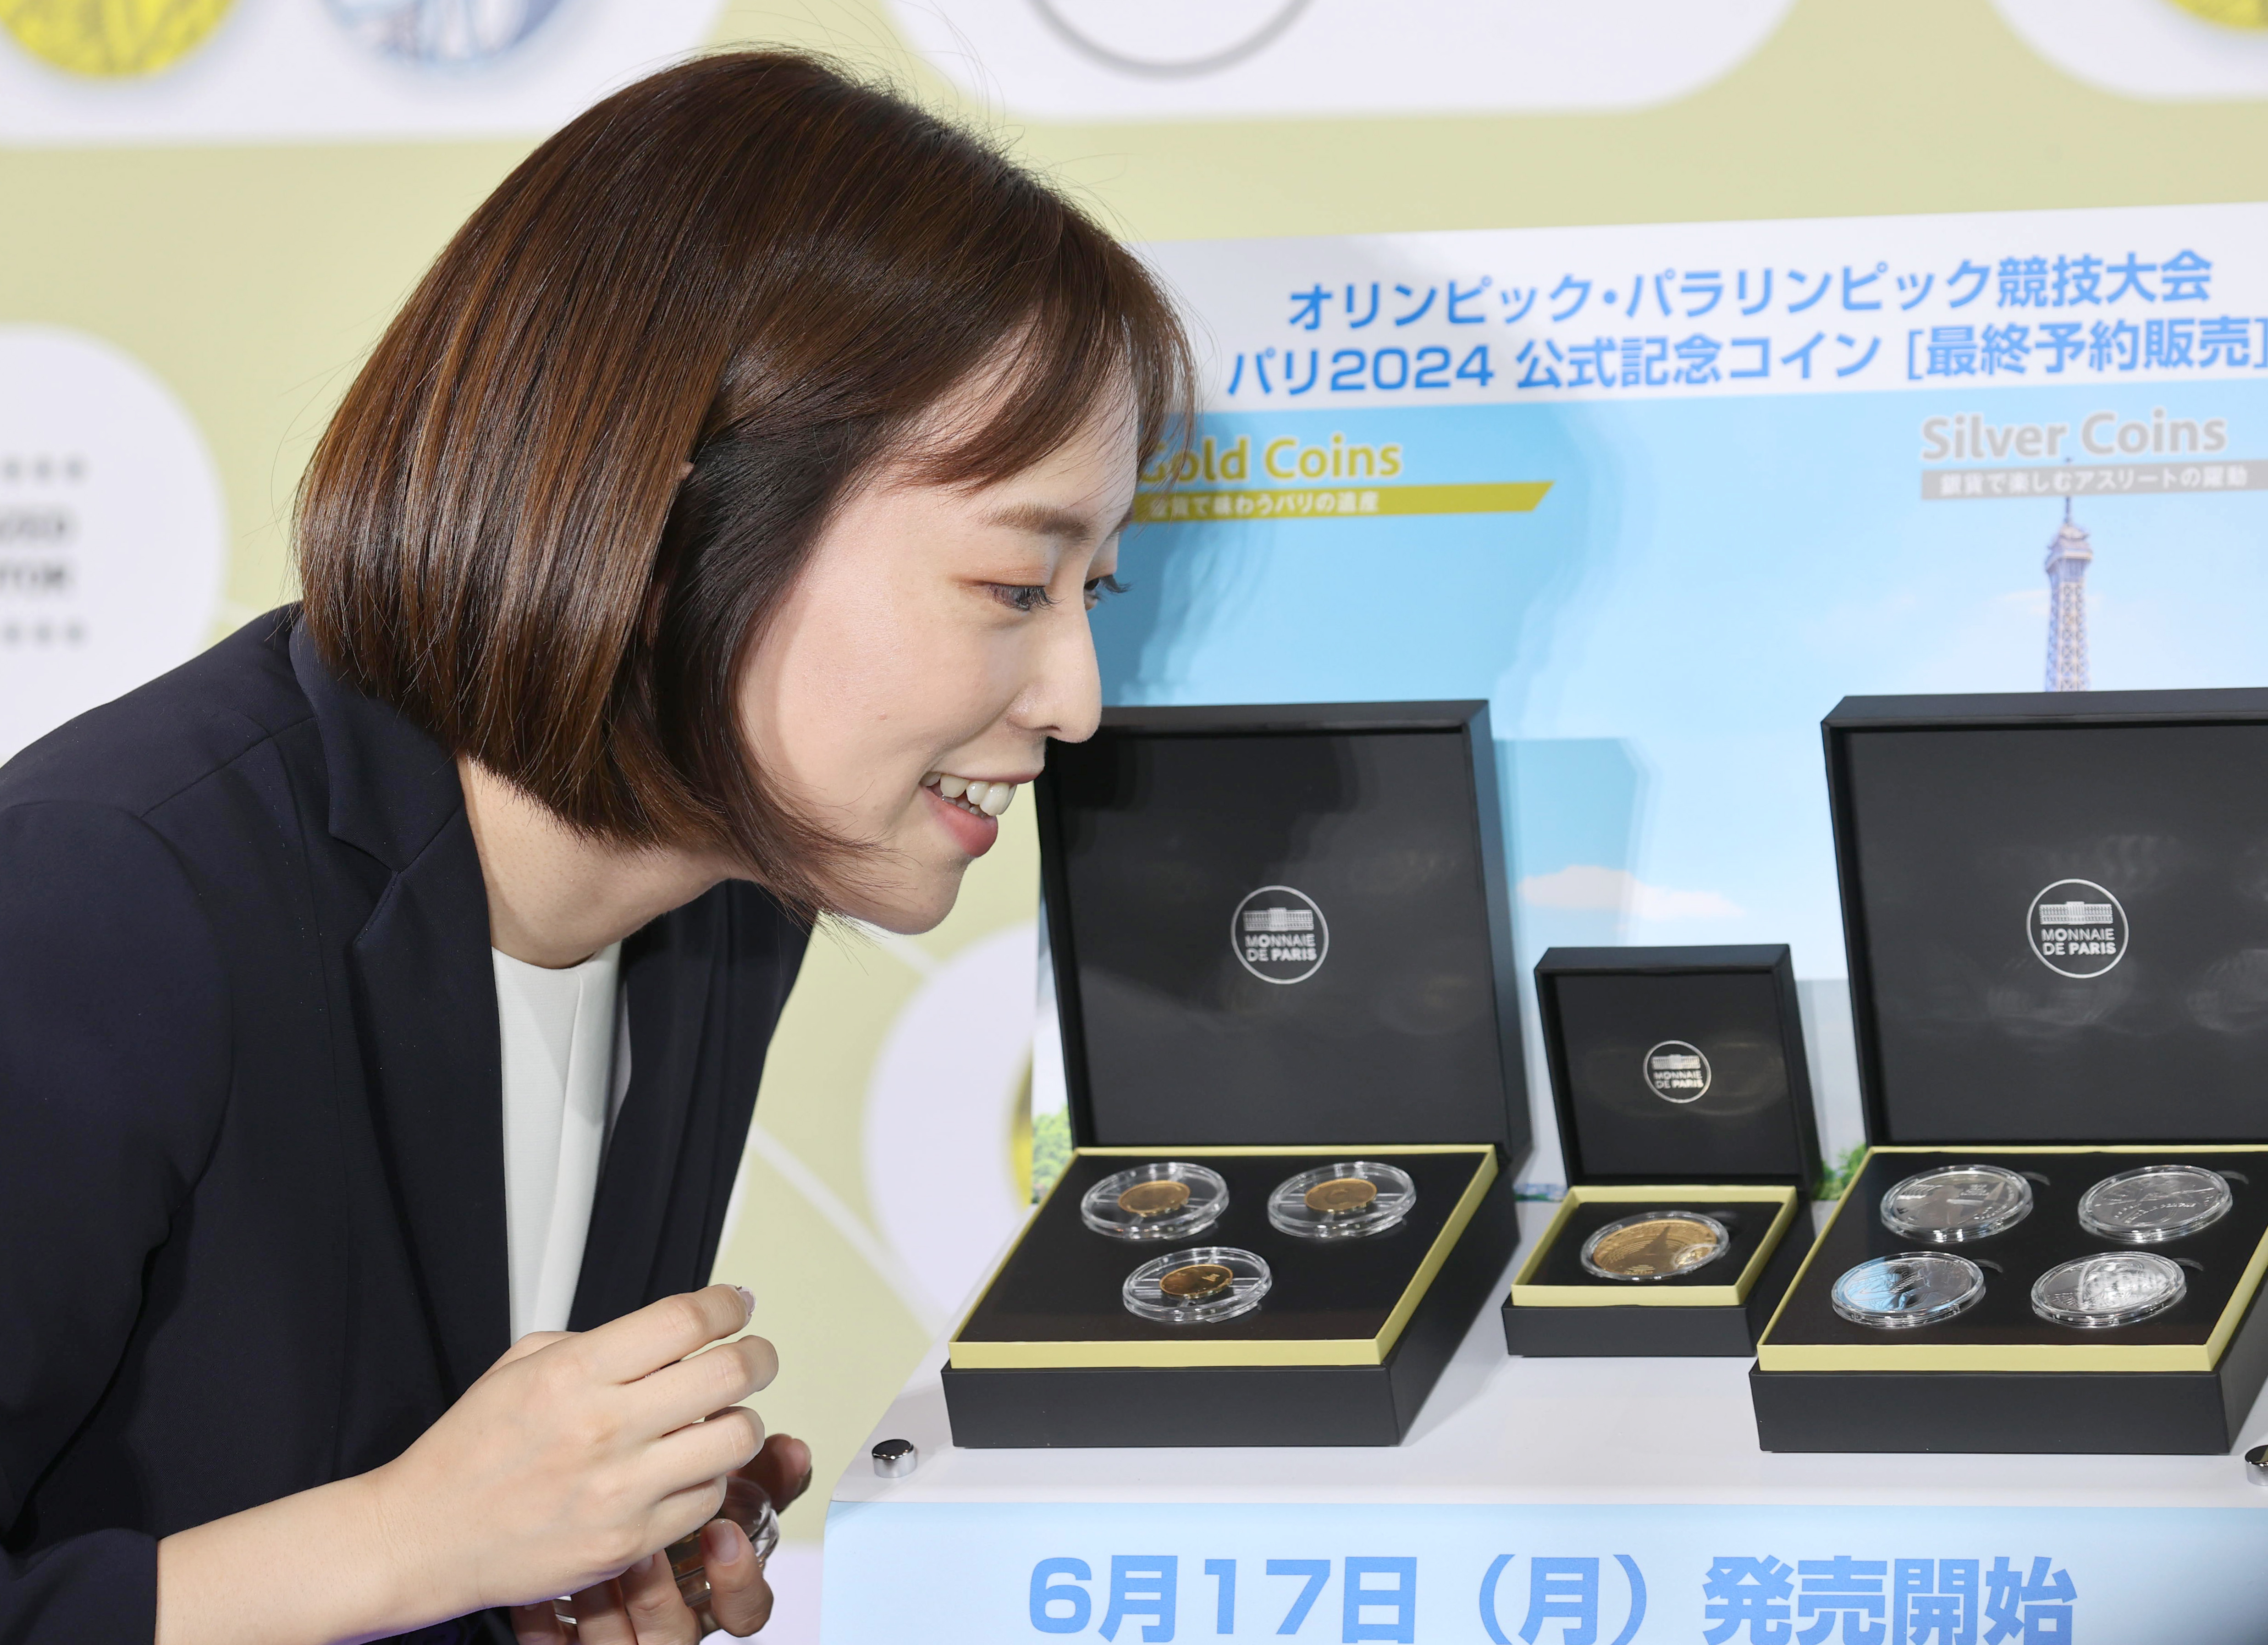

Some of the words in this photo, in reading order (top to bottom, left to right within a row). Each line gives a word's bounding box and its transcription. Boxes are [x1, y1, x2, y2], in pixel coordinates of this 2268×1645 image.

[1288, 249, 2213, 331] オリンピック・パラリンピック競技大会
[1228, 344, 1495, 396] パリ2024
[1516, 331, 1881, 389] 公式記念コイン
[1923, 412, 2067, 460] Silver
[2082, 406, 2227, 457] Coins
[1264, 433, 1401, 479] Coins
[1245, 933, 1316, 948] MONNAIE
[2041, 927, 2115, 942] MONNAIE
[1246, 947, 1269, 962] DE
[1271, 947, 1318, 961] PARIS
[2042, 942, 2066, 955] DE
[2068, 941, 2117, 955] PARIS
[1653, 1069, 1703, 1080] MONNAIE
[1655, 1079, 1671, 1089] DE
[1671, 1078, 1704, 1088] PARIS
